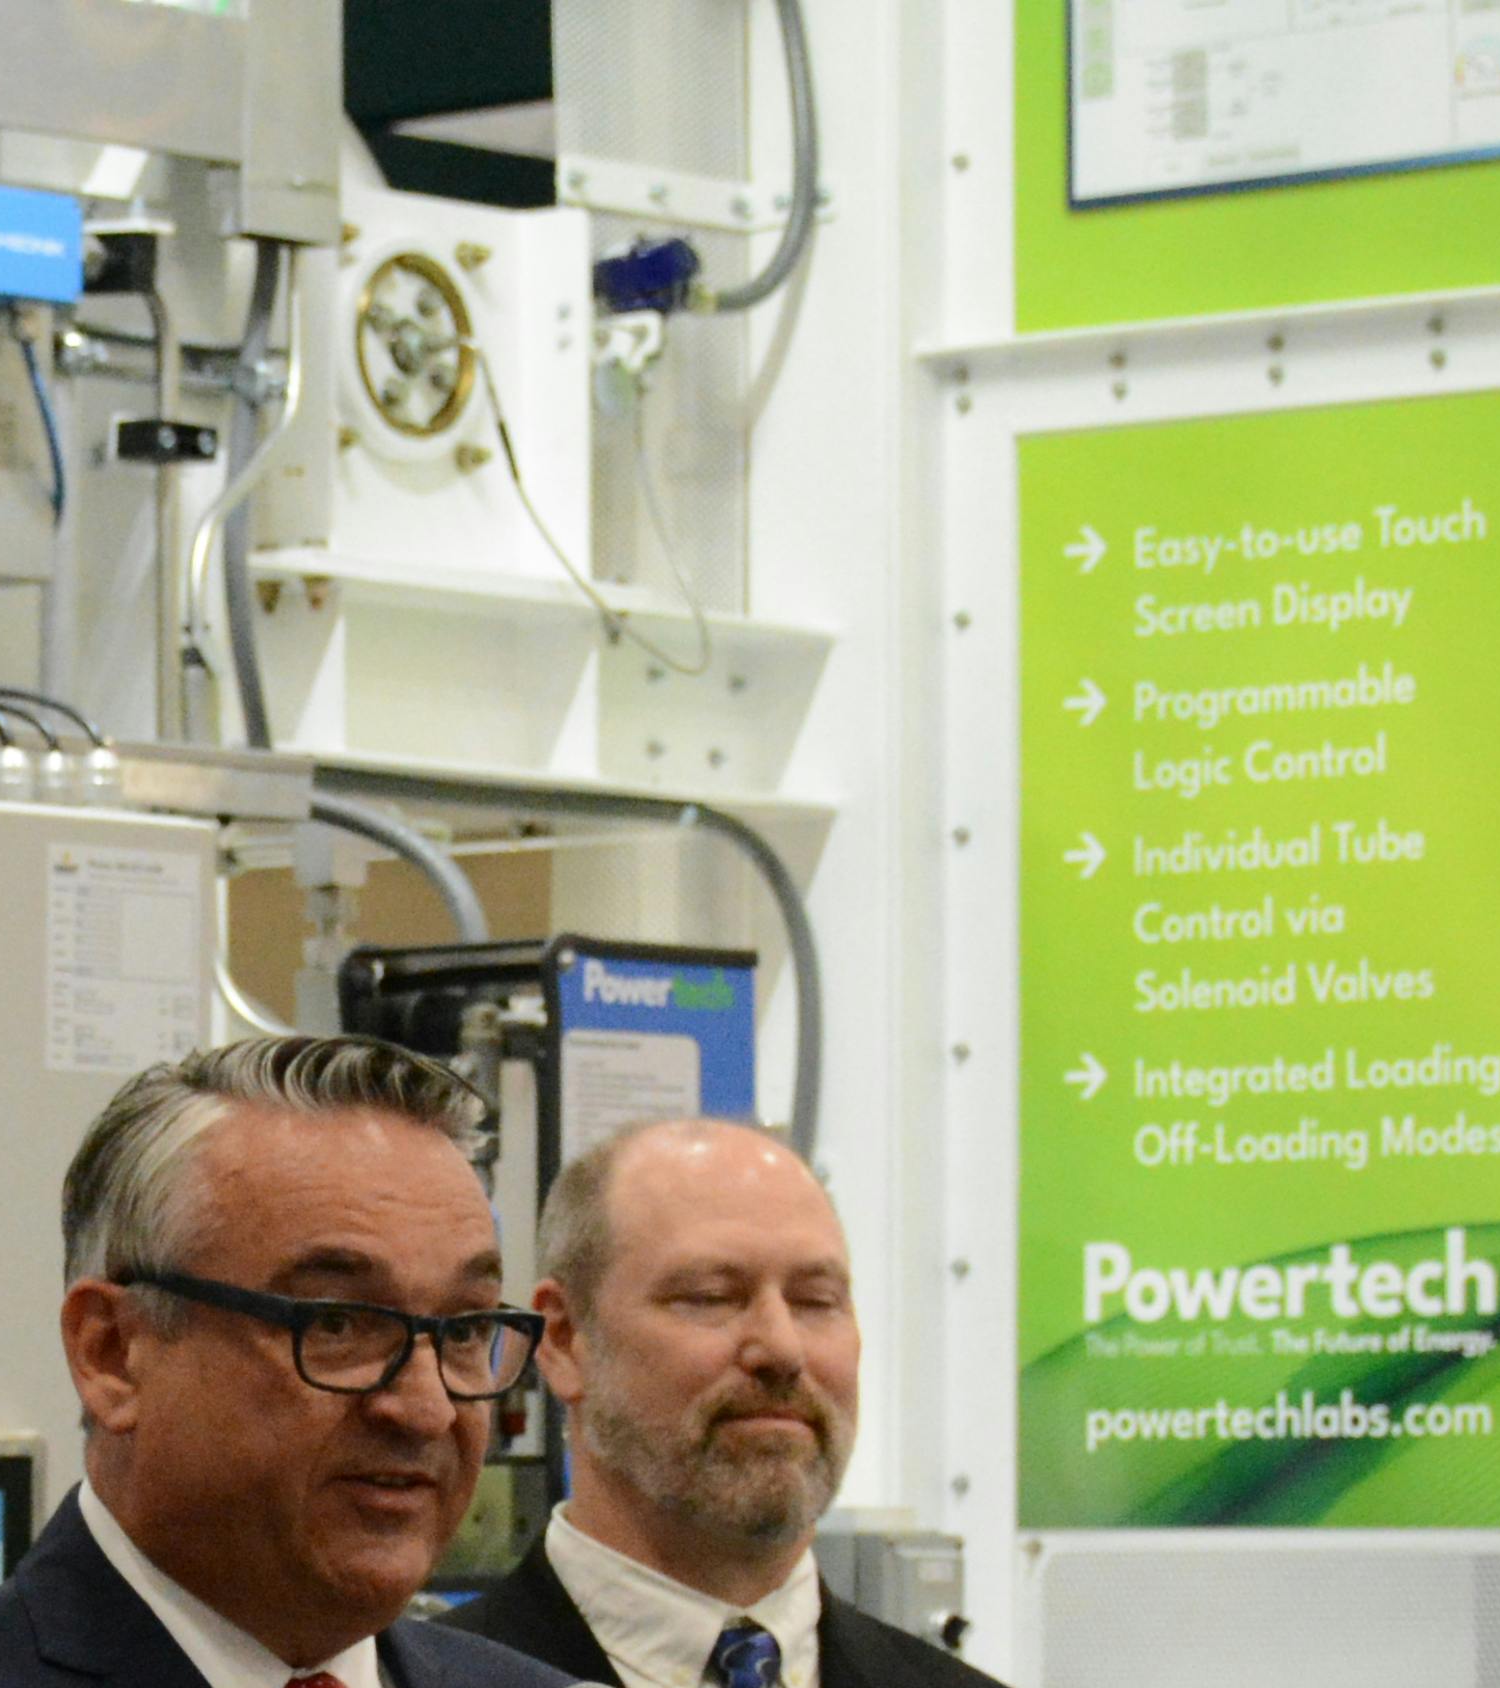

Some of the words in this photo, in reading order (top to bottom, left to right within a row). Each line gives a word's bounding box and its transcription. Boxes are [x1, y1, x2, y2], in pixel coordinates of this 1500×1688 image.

[1134, 520, 1362, 573] Easy-to-use
[1374, 497, 1486, 547] Touch
[1134, 594, 1261, 636] Screen
[1273, 576, 1413, 632] Display
[1134, 661, 1416, 729] Programmable
[1134, 745, 1232, 799] Logic
[1244, 730, 1388, 783] Control
[1134, 823, 1321, 875] Individual
[1331, 818, 1425, 862] Tube
[1133, 895, 1275, 944] Control
[1285, 893, 1346, 936] via
[1134, 962, 1298, 1013] Solenoid
[1306, 956, 1435, 1004] Valves
[1134, 1047, 1335, 1107] Integrated
[1134, 1115, 1369, 1171] Off-Loading
[1083, 1227, 1499, 1323] Powertech
[1272, 1328, 1309, 1353] The
[1313, 1327, 1382, 1353] Future
[1385, 1324, 1412, 1351] of
[1415, 1326, 1499, 1358] Energy.
[1085, 1389, 1493, 1452] powertechlabs.com
